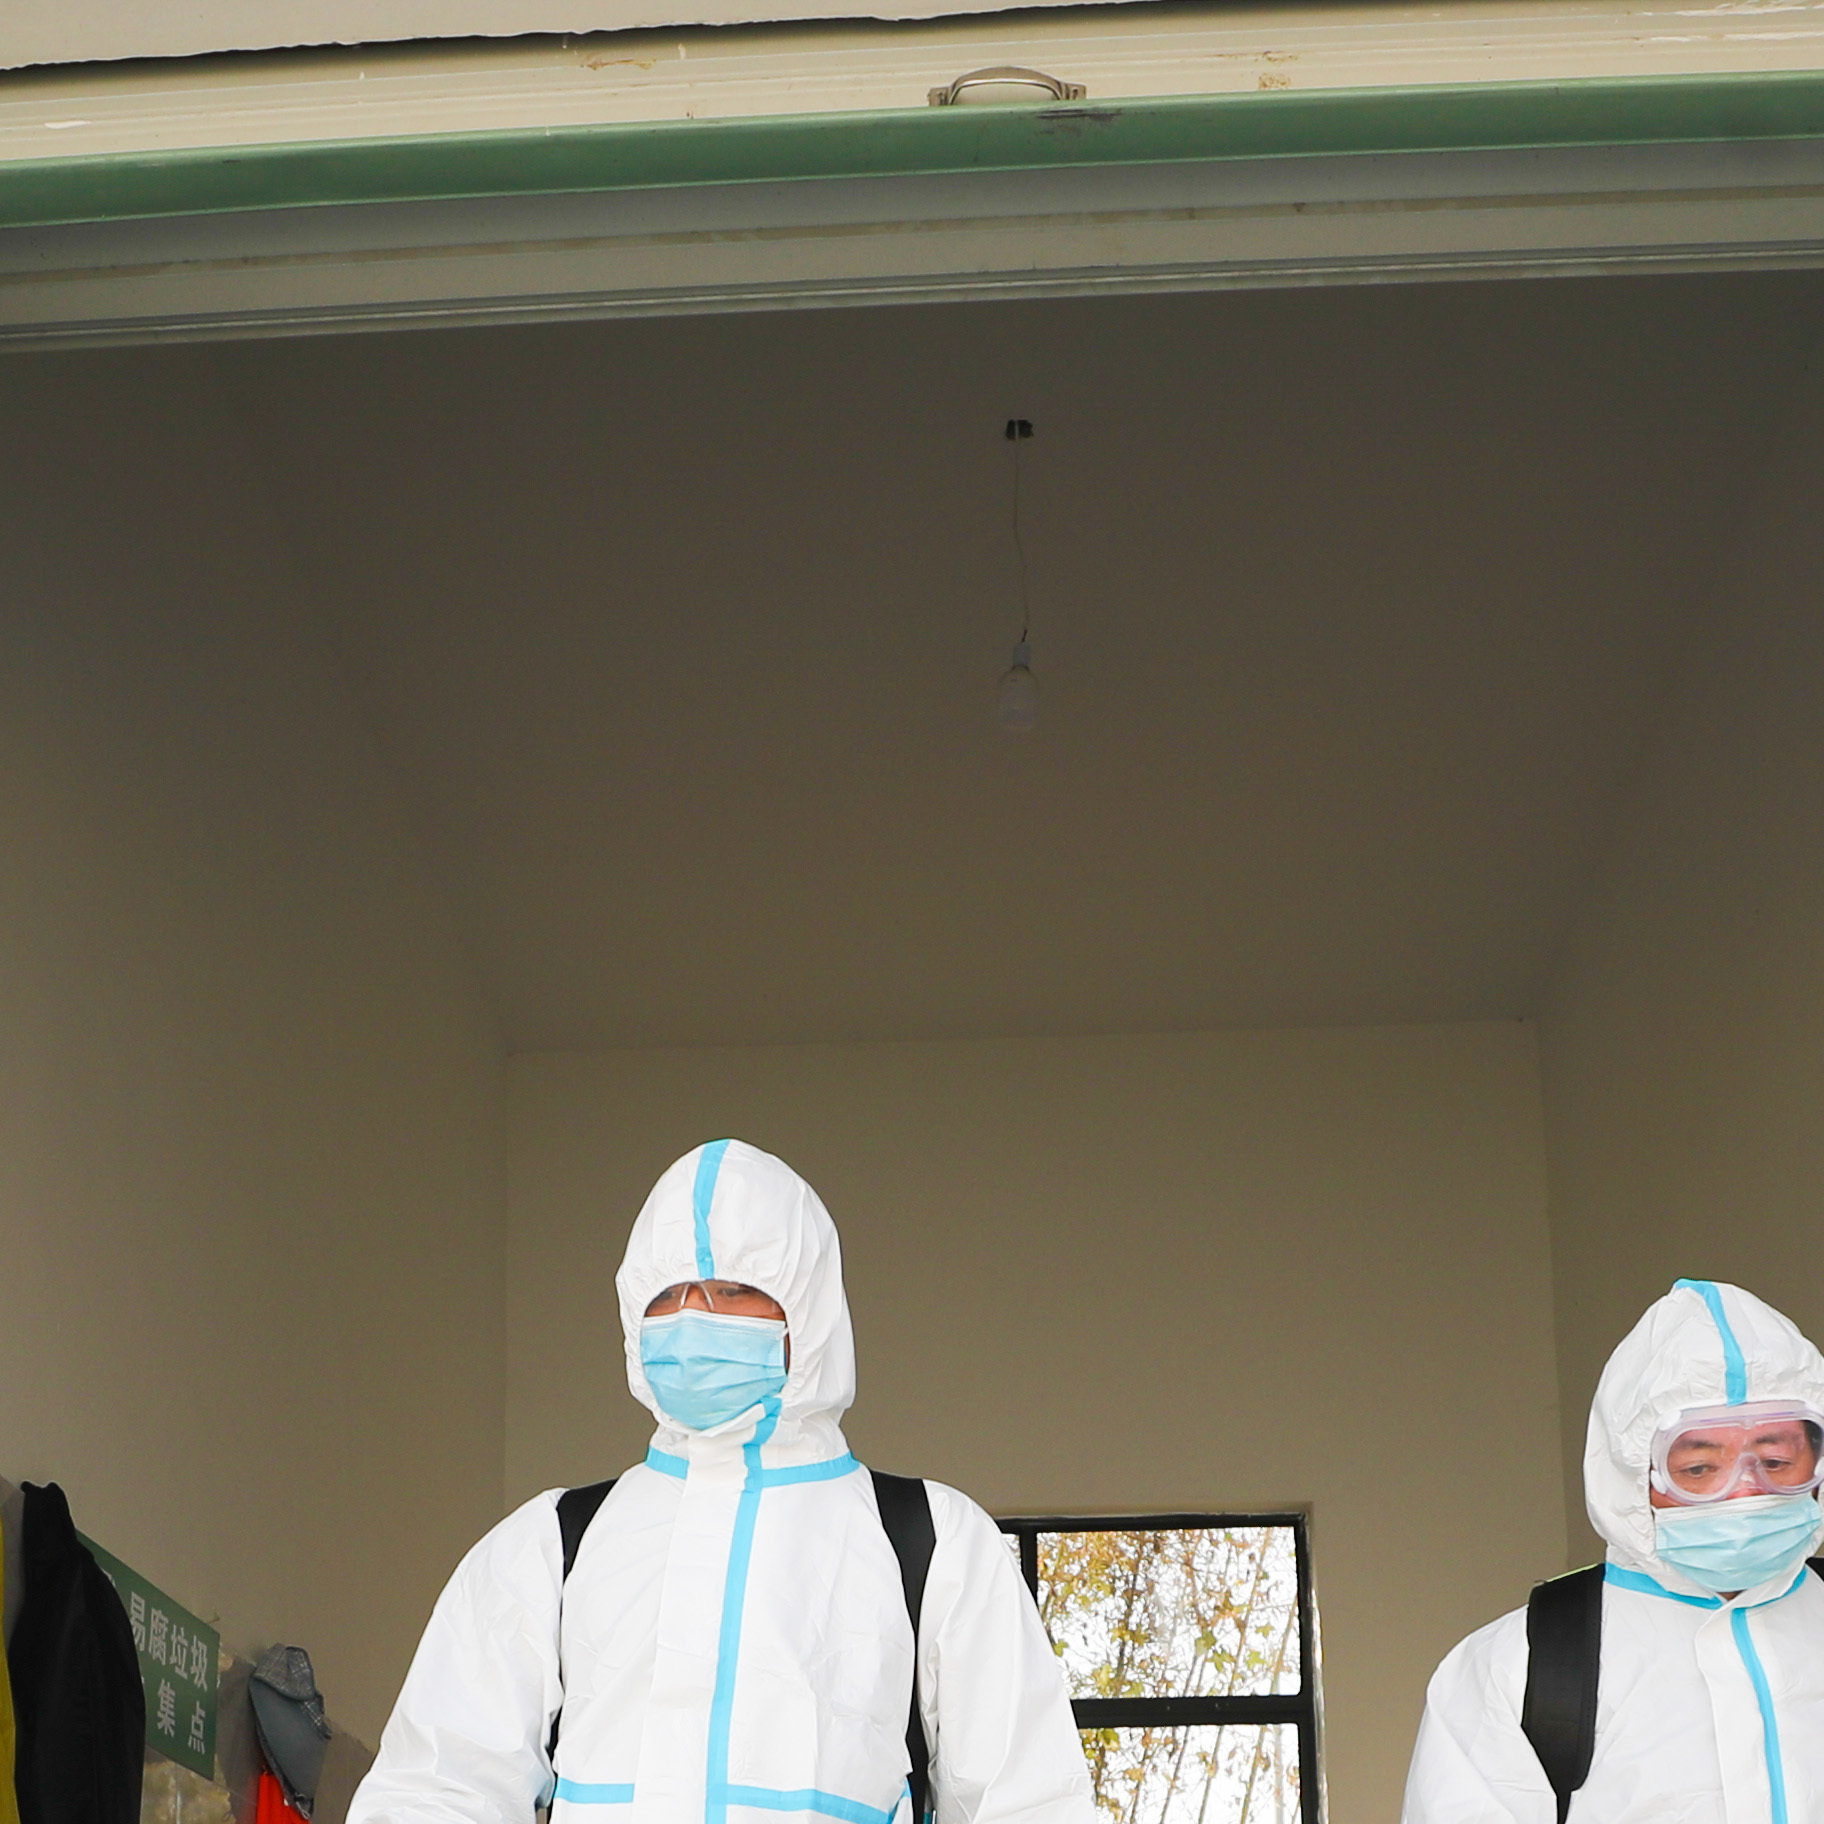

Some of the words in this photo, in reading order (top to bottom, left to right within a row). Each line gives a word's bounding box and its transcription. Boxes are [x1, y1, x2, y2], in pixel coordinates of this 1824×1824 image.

[129, 1591, 208, 1692] 易腐垃圾
[141, 1676, 207, 1755] 集点
